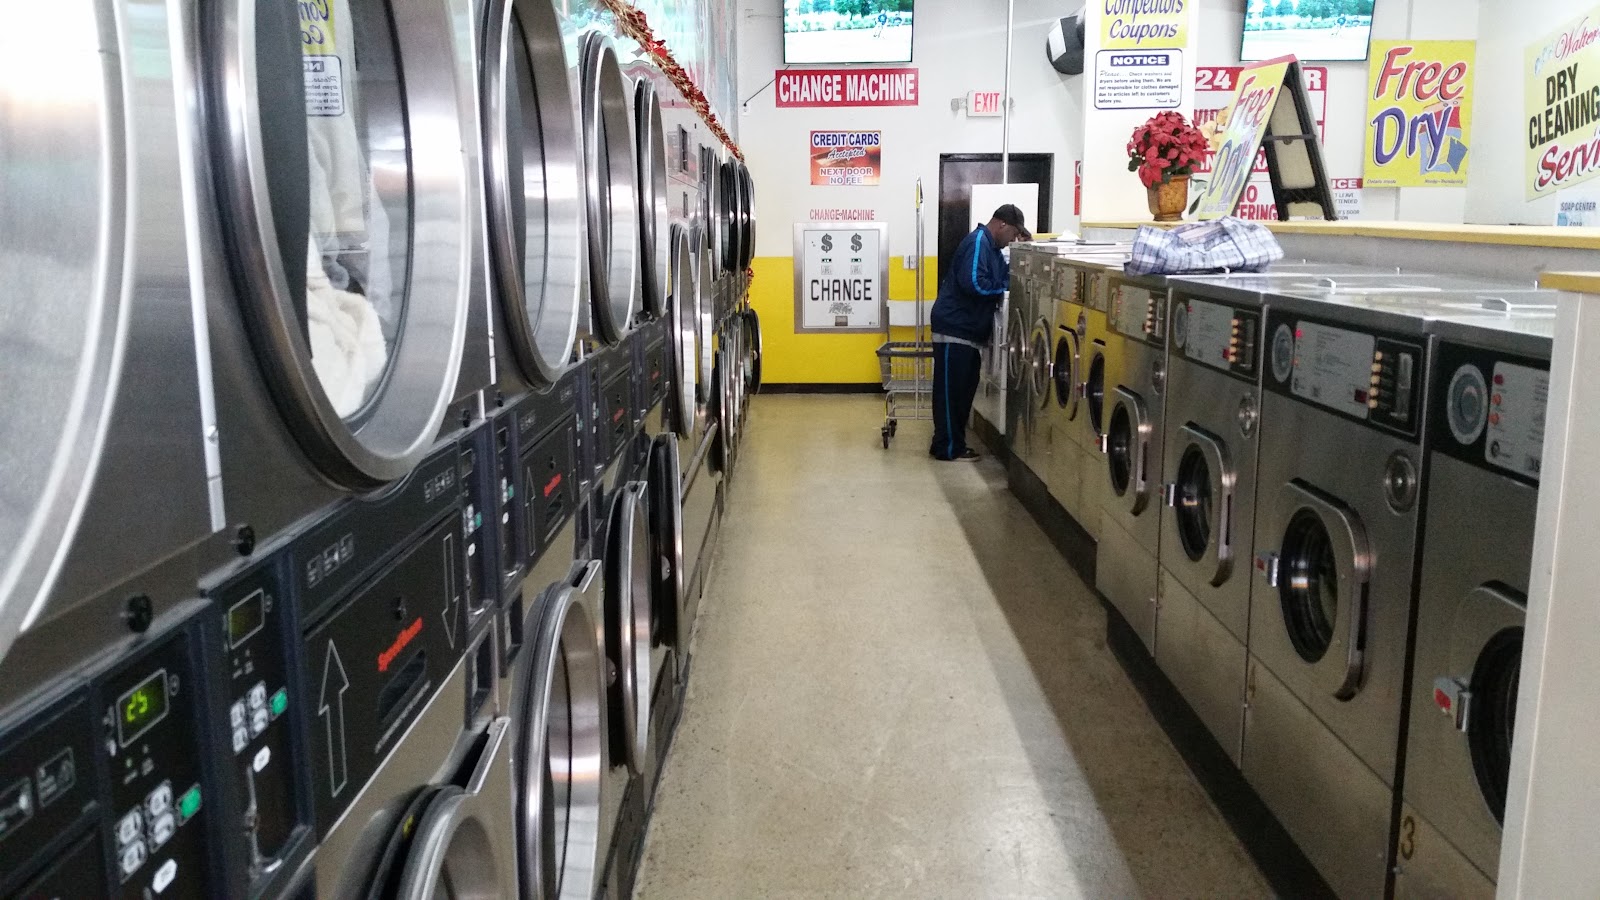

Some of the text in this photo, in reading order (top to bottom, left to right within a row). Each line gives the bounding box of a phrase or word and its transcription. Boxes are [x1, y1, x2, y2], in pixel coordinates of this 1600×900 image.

[1109, 19, 1178, 44] Coupons
[1113, 56, 1167, 65] NOTICE
[1195, 70, 1231, 89] 24
[1374, 46, 1467, 101] Free
[1546, 62, 1578, 106] DRY
[779, 73, 915, 103] CHANGE MACHINE
[974, 92, 1000, 112] EXIT
[1226, 75, 1275, 130] Free
[1529, 85, 1600, 149] CLEANING
[813, 133, 879, 146] CREDIT CARDS
[1371, 106, 1453, 170] Dry
[820, 168, 845, 176] NEXT
[1240, 185, 1258, 203] O
[810, 209, 875, 220] CHANGE MACHINE
[1575, 202, 1596, 211] CENTER
[821, 233, 863, 253] $ $
[811, 279, 872, 301] CHANGE
[126, 690, 148, 722] 25
[1401, 815, 1415, 860] 3
